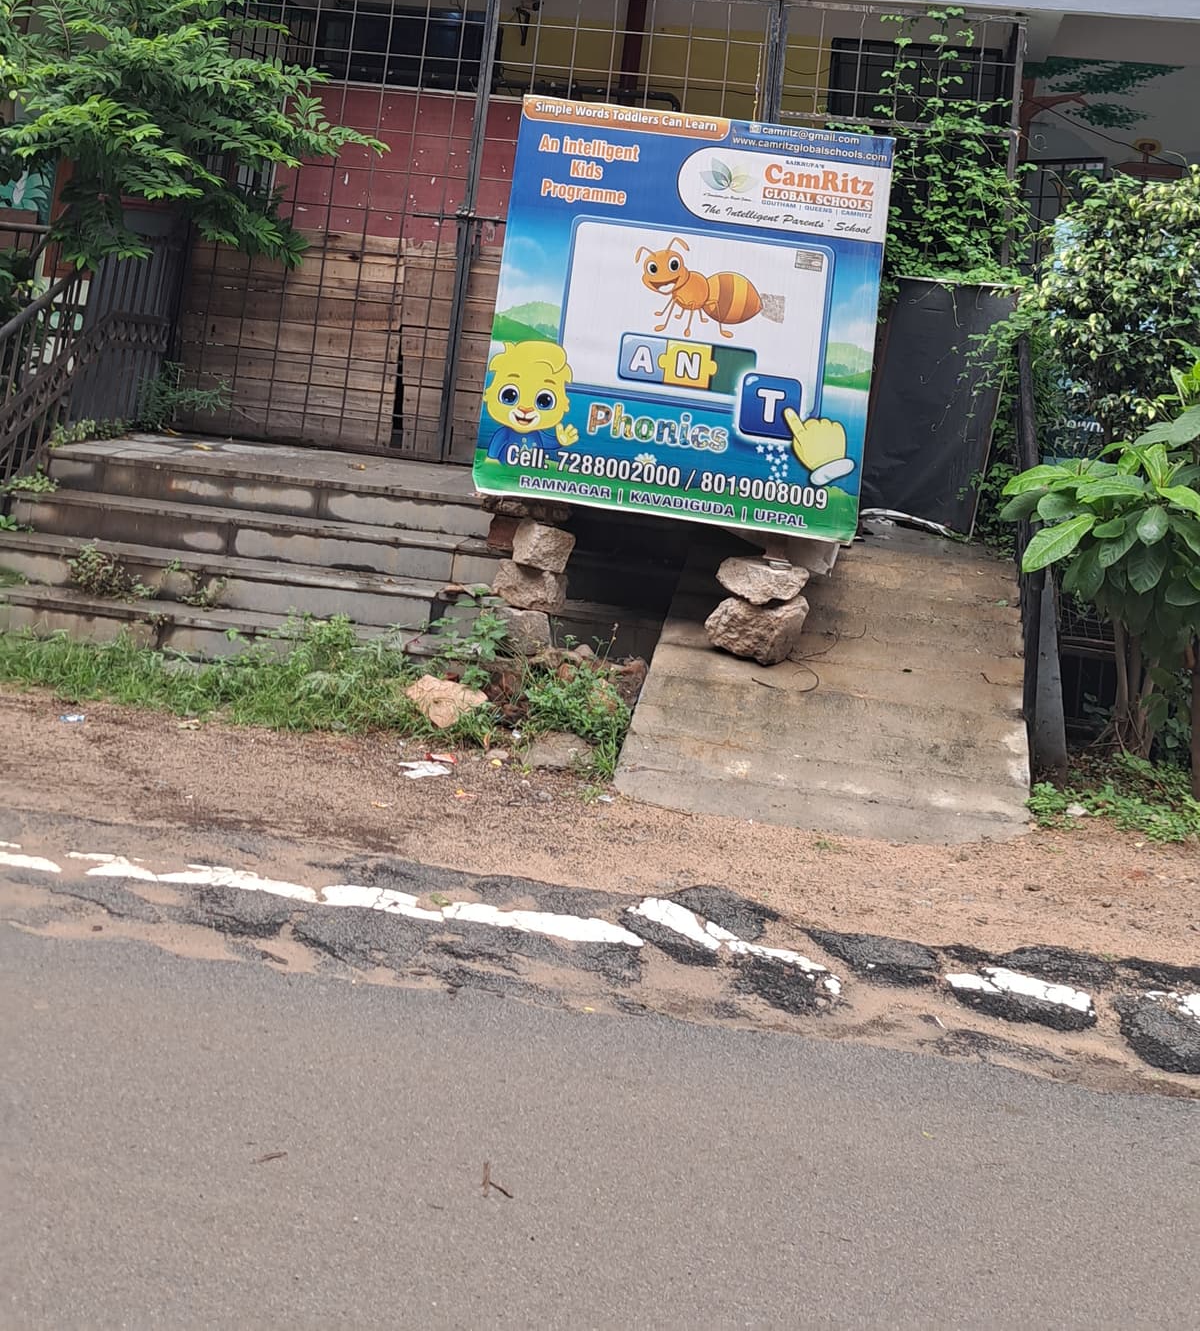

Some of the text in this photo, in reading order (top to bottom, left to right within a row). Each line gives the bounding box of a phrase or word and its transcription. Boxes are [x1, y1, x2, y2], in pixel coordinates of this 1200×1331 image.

[535, 101, 718, 132] Simple Words Toddlers Can Learn
[539, 134, 640, 162] An intelligent
[732, 136, 888, 162] www.camritzglobalschools.com
[762, 126, 860, 145] camritz@gmail.com
[570, 159, 603, 180] Kids
[764, 163, 874, 197] CamRitz
[540, 178, 627, 205] Programme
[764, 188, 815, 206] GLOBAL
[815, 193, 873, 210] SCHOOLS
[702, 203, 721, 215] The
[725, 206, 780, 223] Intelligent
[834, 221, 872, 235] School
[629, 345, 702, 380] A N
[756, 387, 786, 424] T
[586, 402, 730, 454] Phonics
[506, 445, 549, 471] Cell:
[556, 451, 681, 488] 7288002000
[700, 472, 828, 510] 8019008009
[518, 475, 611, 500] RAMNAGAR
[630, 490, 735, 518] KAVADIGUDA
[754, 509, 808, 529] UPPAL
